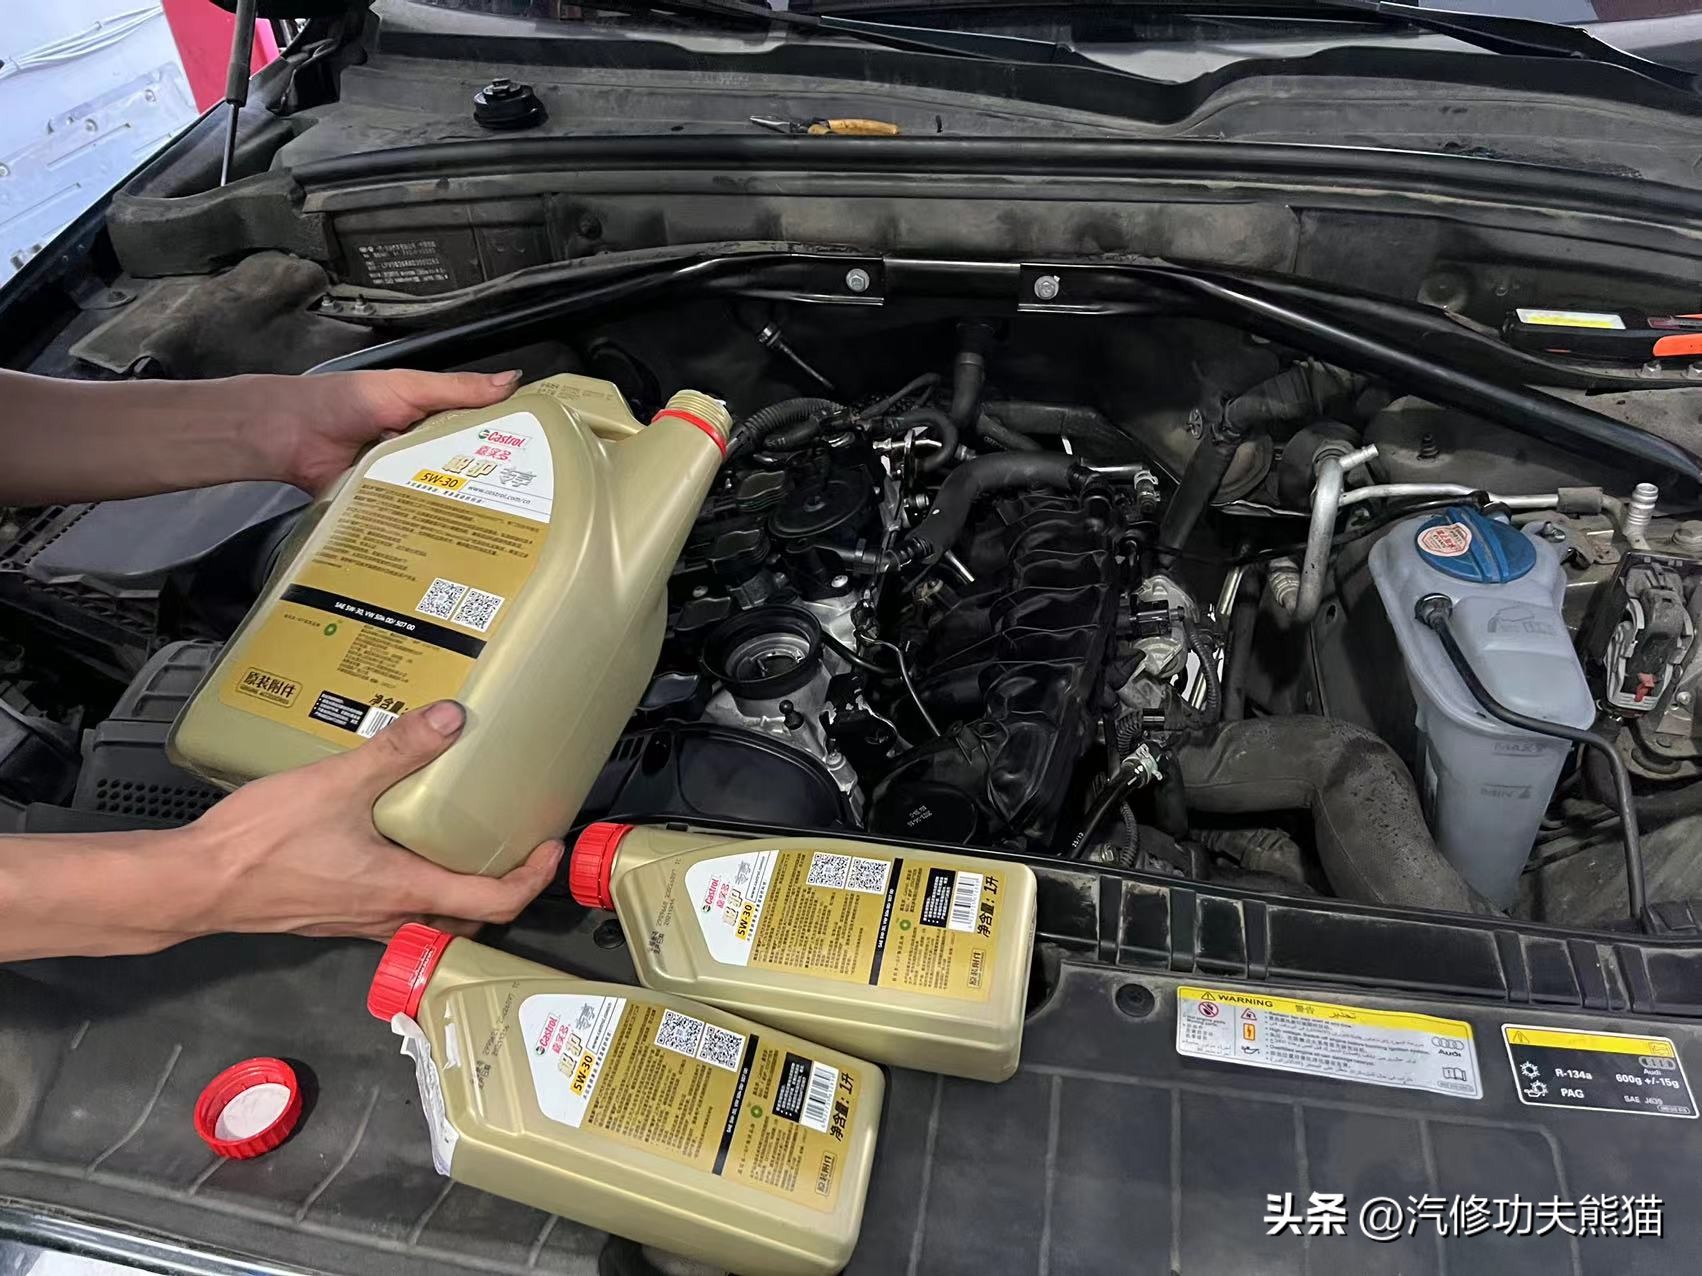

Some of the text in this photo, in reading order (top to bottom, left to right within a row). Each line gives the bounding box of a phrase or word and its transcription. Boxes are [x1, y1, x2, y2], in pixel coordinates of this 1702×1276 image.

[487, 430, 526, 448] Castrol
[420, 472, 459, 488] 5W-30
[243, 671, 296, 698] 原装附件
[705, 878, 719, 905] Castrol
[738, 904, 752, 936] 5W-30
[1218, 994, 1273, 1008] WARNING
[539, 1017, 558, 1047] Castrol
[1438, 1049, 1461, 1057] Audi
[573, 1055, 593, 1091] 5W-30
[1555, 1069, 1680, 1088] R-134a 600g +/-15g
[1561, 1088, 1585, 1098] PAG
